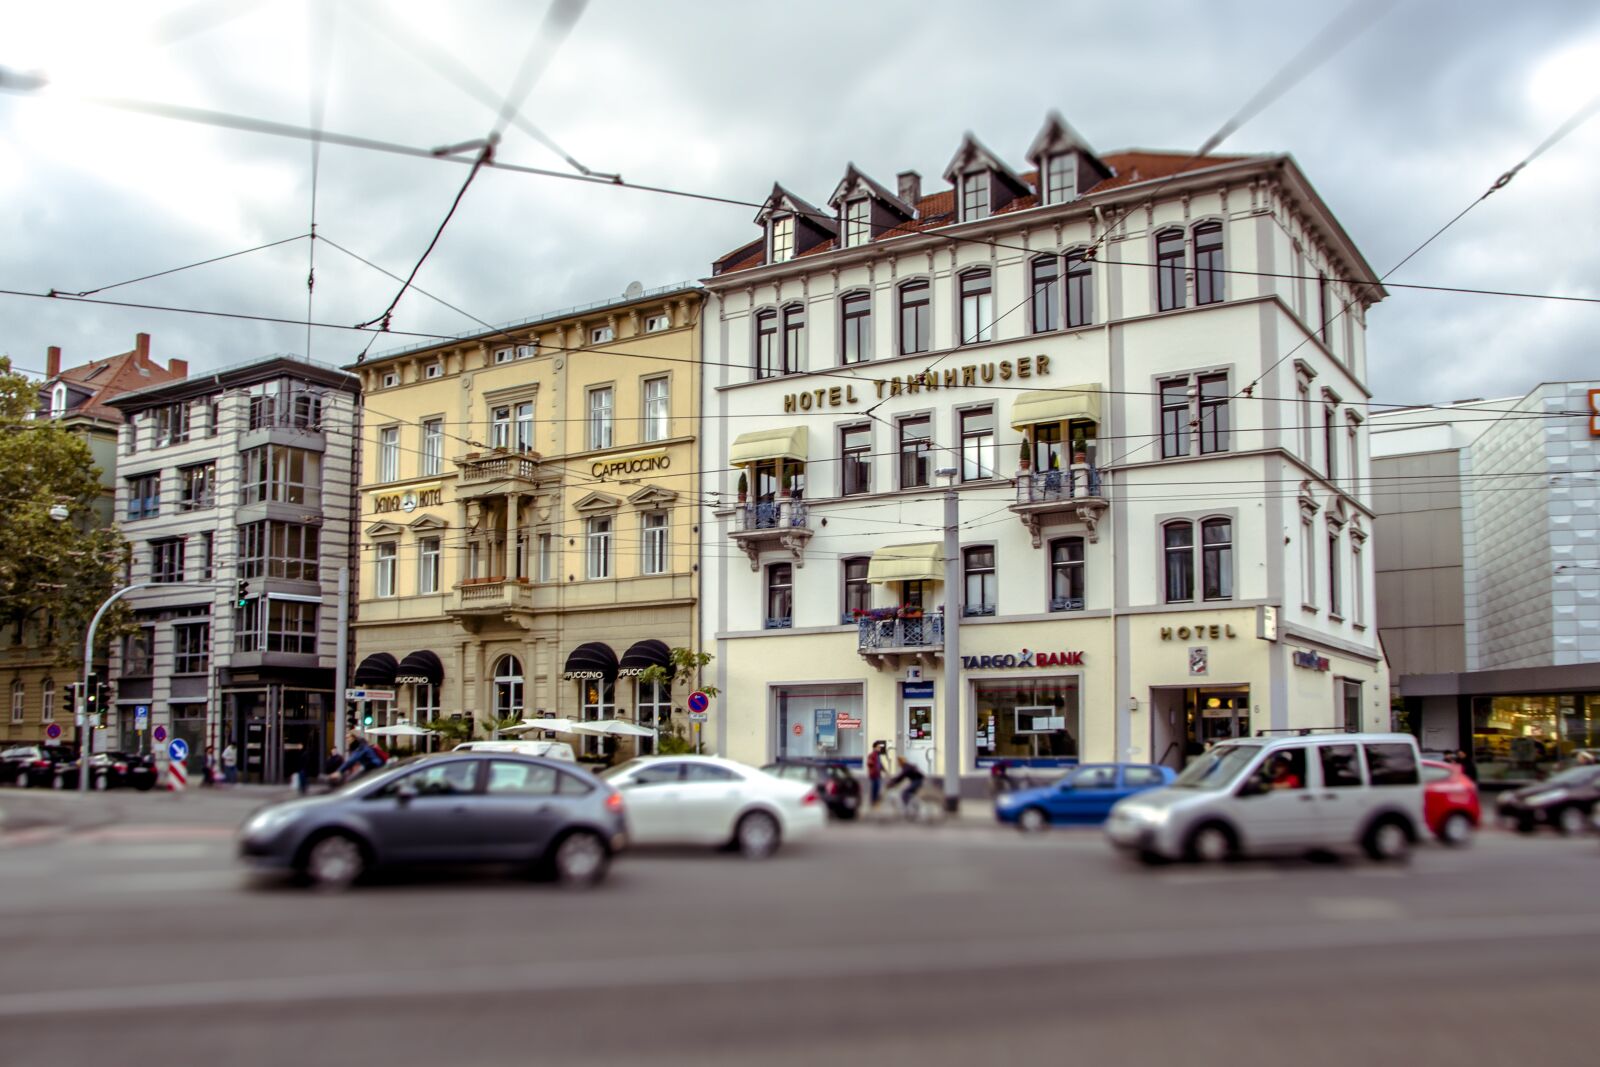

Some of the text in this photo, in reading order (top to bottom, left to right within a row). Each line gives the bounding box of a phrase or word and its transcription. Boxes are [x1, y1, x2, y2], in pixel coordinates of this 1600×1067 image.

[784, 384, 858, 413] HOTEL
[591, 456, 671, 478] CAPPUCCINO
[419, 488, 444, 508] HOTEL
[1160, 623, 1236, 641] HOTEL
[960, 651, 1084, 669] TARGO BANK
